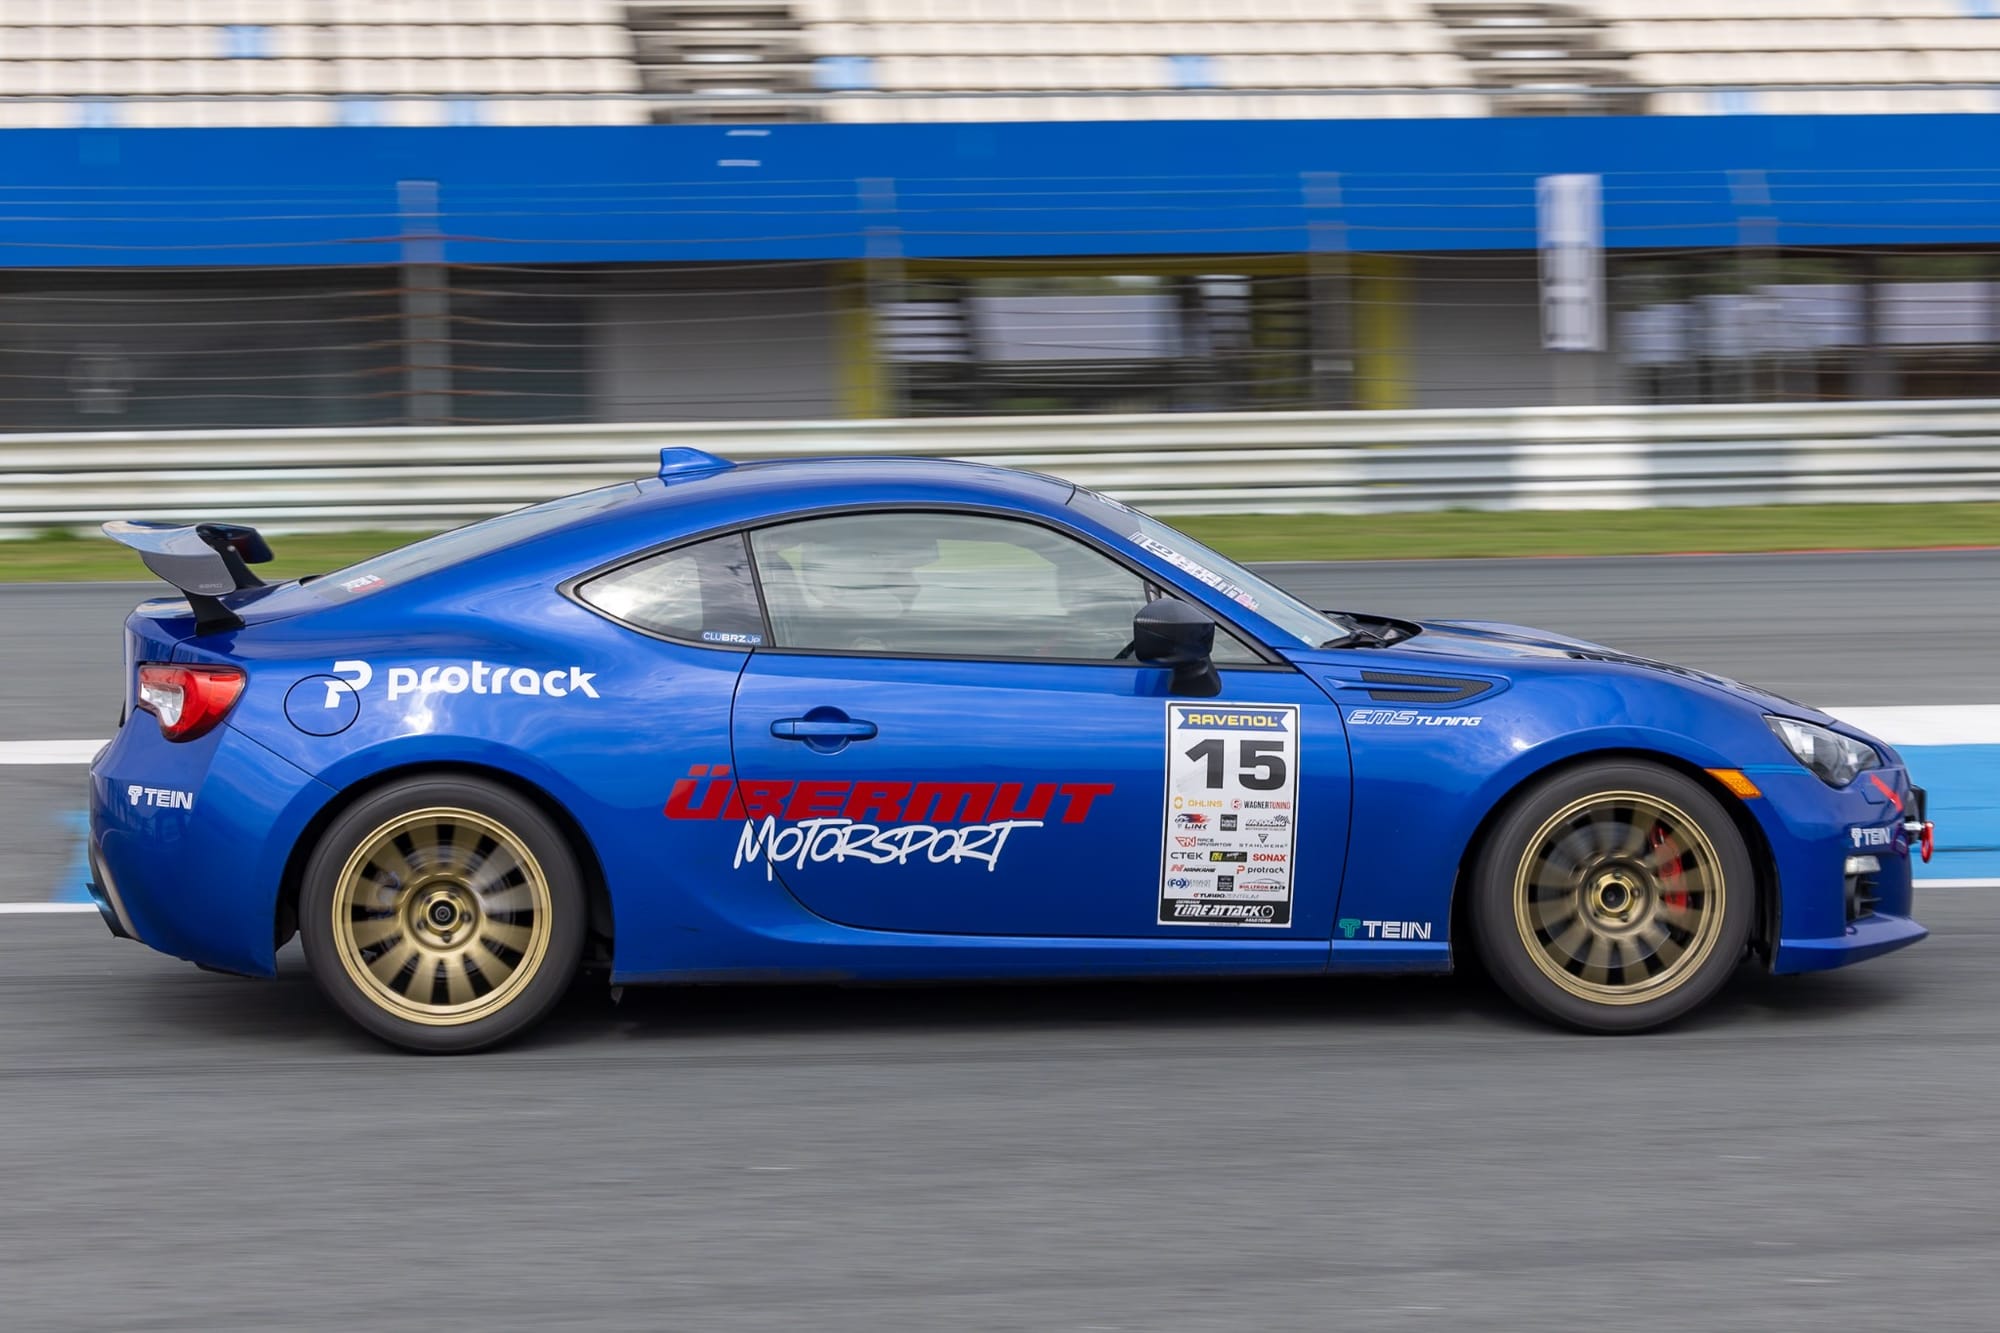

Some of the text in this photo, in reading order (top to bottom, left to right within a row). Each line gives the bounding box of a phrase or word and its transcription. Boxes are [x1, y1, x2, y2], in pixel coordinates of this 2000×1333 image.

[388, 660, 600, 701] protrack
[1188, 713, 1278, 728] RAVENOL
[1347, 709, 1482, 727] EMS TUNING
[1185, 739, 1286, 790] 15
[144, 787, 193, 810] TEIN
[663, 764, 1115, 824] ÜBERMUT
[1862, 827, 1891, 846] TEIN
[733, 815, 1044, 881] MOTORSPORT
[1170, 851, 1204, 860] CTEK
[1252, 853, 1287, 862] SONAX
[1247, 866, 1285, 874] protrack
[1362, 920, 1432, 940] TEIN
